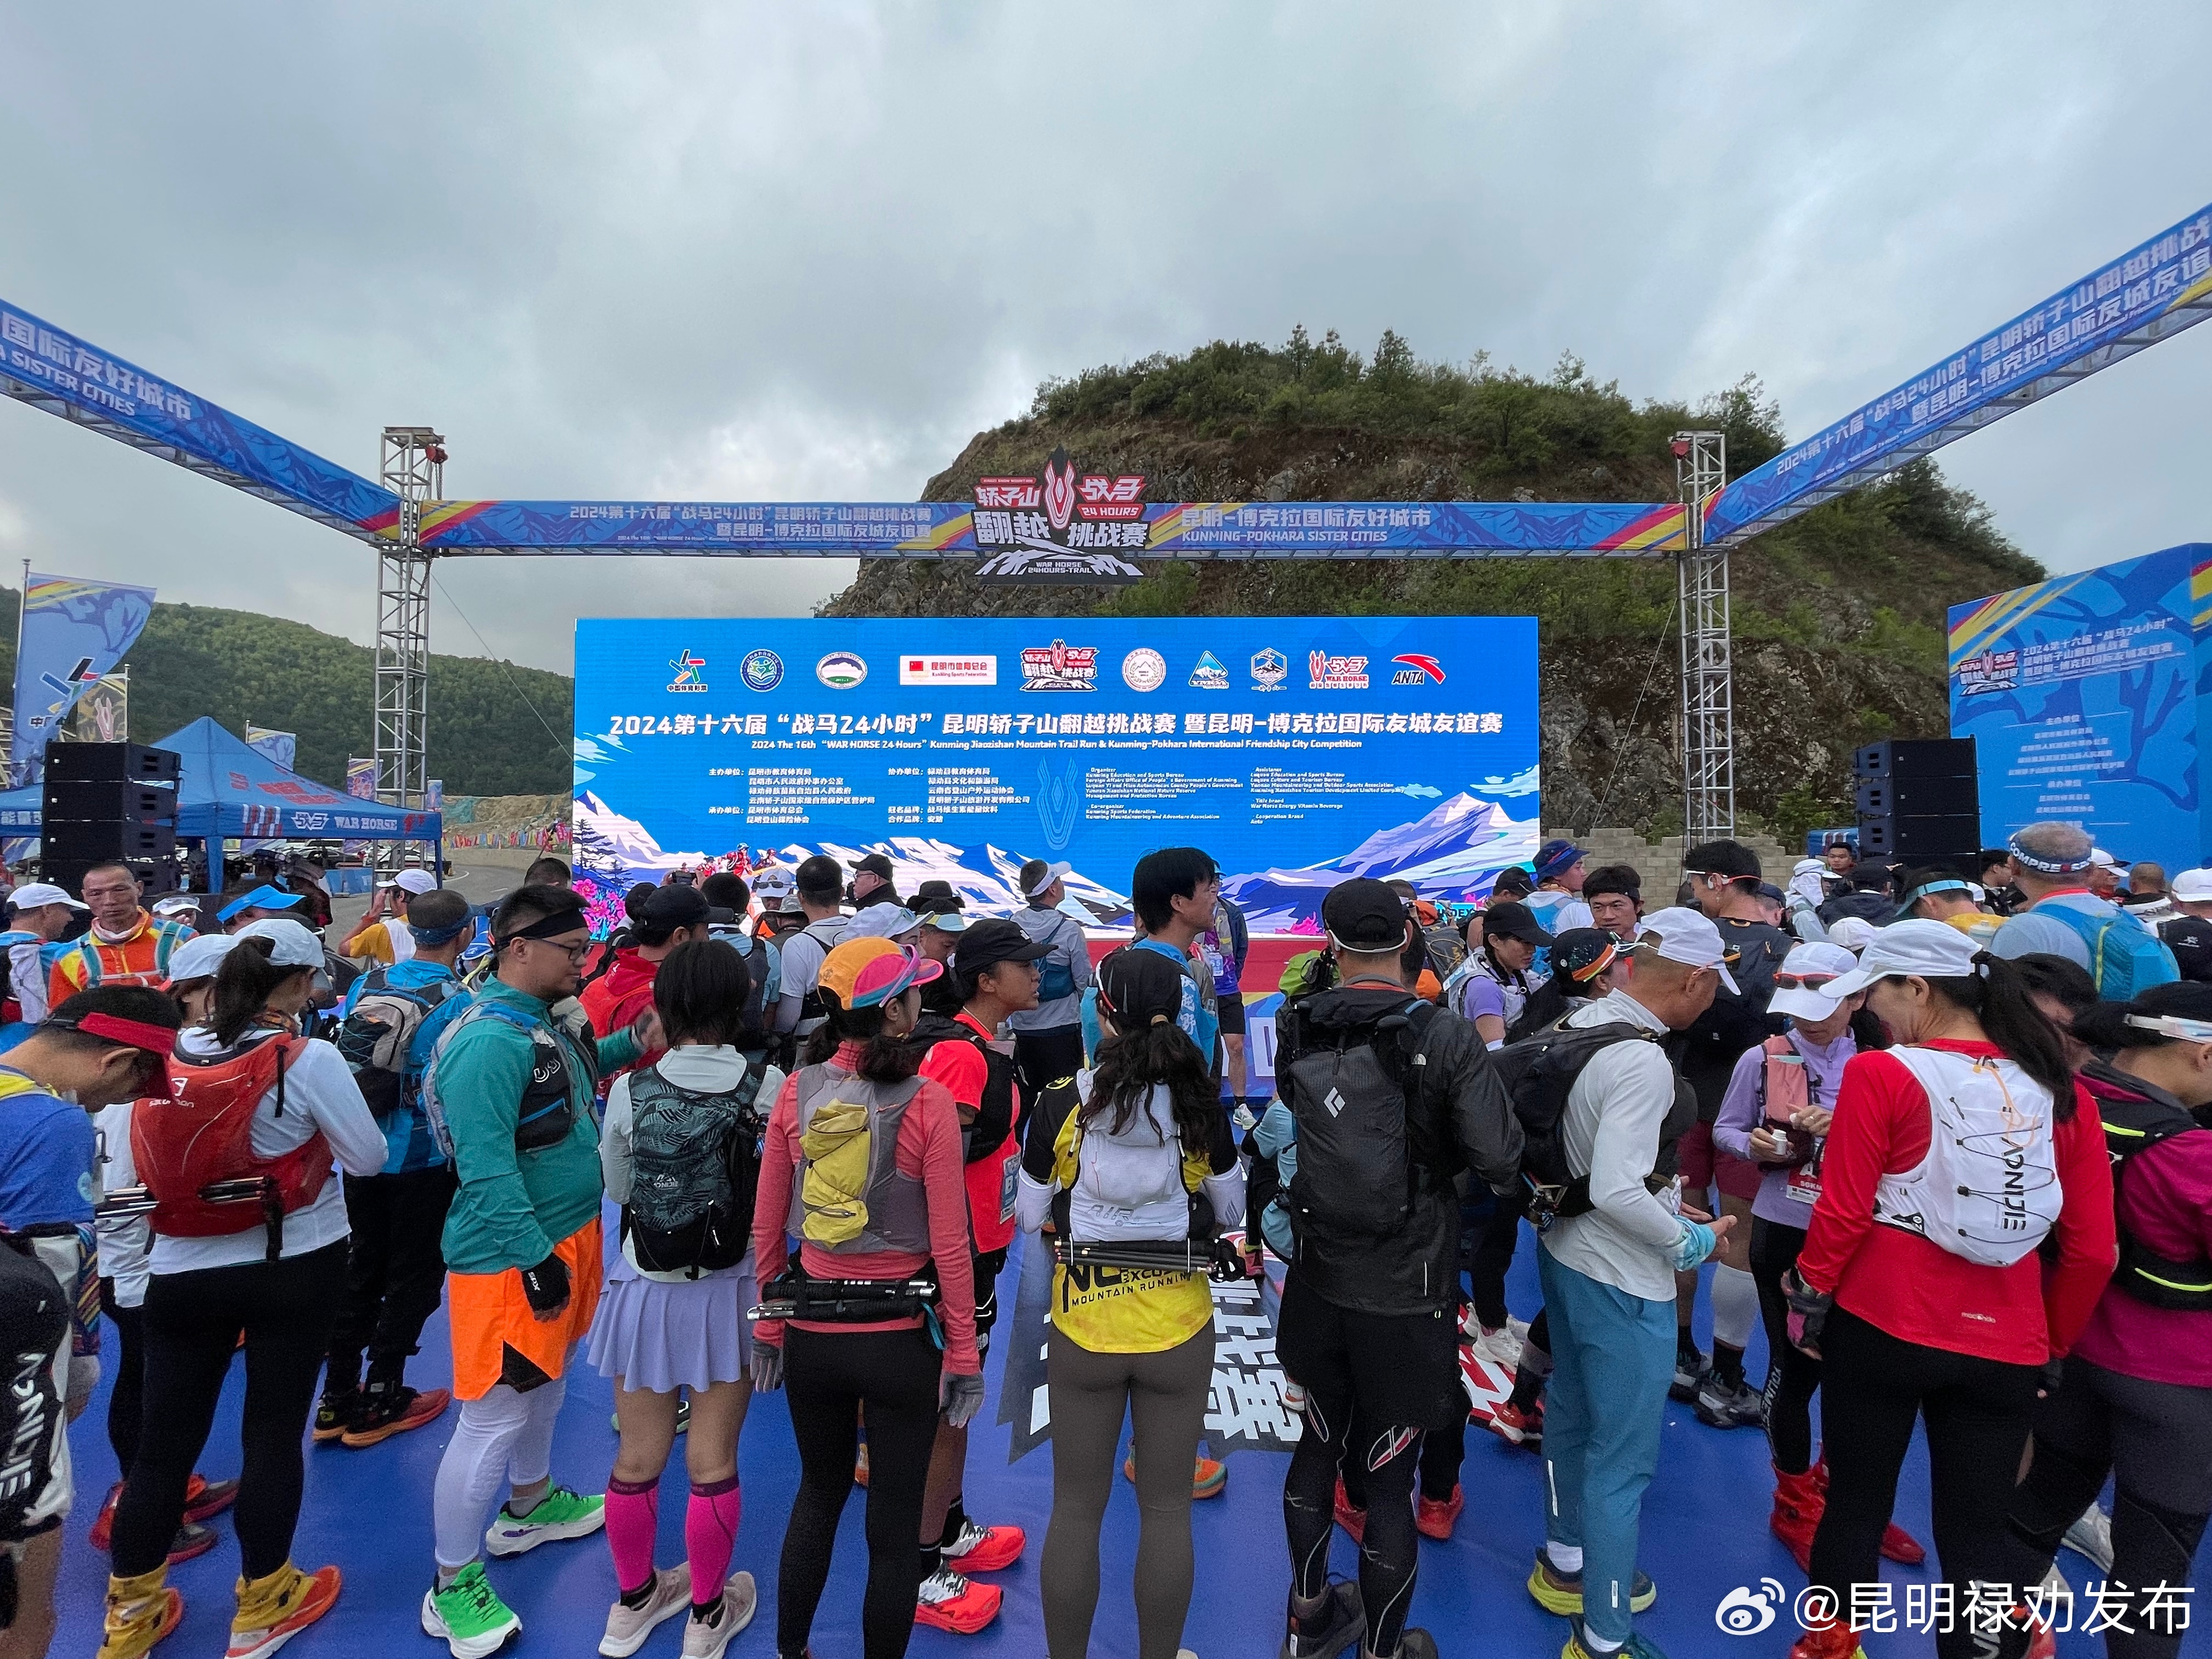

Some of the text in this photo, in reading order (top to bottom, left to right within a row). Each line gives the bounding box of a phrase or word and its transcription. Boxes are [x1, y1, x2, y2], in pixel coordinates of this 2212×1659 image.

[2, 311, 191, 420] 国际友好城市
[12, 350, 136, 416] SISTER CITIES
[975, 487, 1041, 506] 轿子山
[1080, 478, 1144, 501] 战马
[1082, 507, 1138, 516] 24 HOURS
[1182, 509, 1431, 527] 昆明-博克拉国际友好城市
[716, 522, 932, 537] 暨昆明-博克拉国际友城友谊赛
[973, 511, 1050, 544] 翻越
[1066, 522, 1148, 548] 挑战赛
[1182, 531, 1387, 541] KUNMING-POKHARA SISTER CITIES
[1393, 672, 1424, 684] ANTA
[1184, 713, 1503, 734] 暨昆明-博克拉国际友城友谊赛
[752, 740, 775, 748] 2024
[777, 740, 793, 748] The
[796, 740, 816, 748] 16th
[850, 740, 880, 748] HORSE
[882, 740, 894, 748] 24
[930, 740, 969, 751] Kunming
[971, 740, 1014, 748] Jiaozishan
[1016, 740, 1057, 748] Mountain
[1059, 740, 1078, 748] Trail
[1080, 740, 1097, 748] Run
[1099, 740, 1107, 748] &
[1108, 740, 1187, 750] Kunming-Pokhara
[1189, 740, 1243, 748] International
[1246, 740, 1290, 750] Friendship
[1292, 740, 1308, 750] City
[1311, 740, 1362, 749] Competition
[335, 816, 398, 831] WAR HORSE
[2001, 1137, 2026, 1230] AONIJIE
[1071, 1285, 1134, 1307] MOUNTAIN
